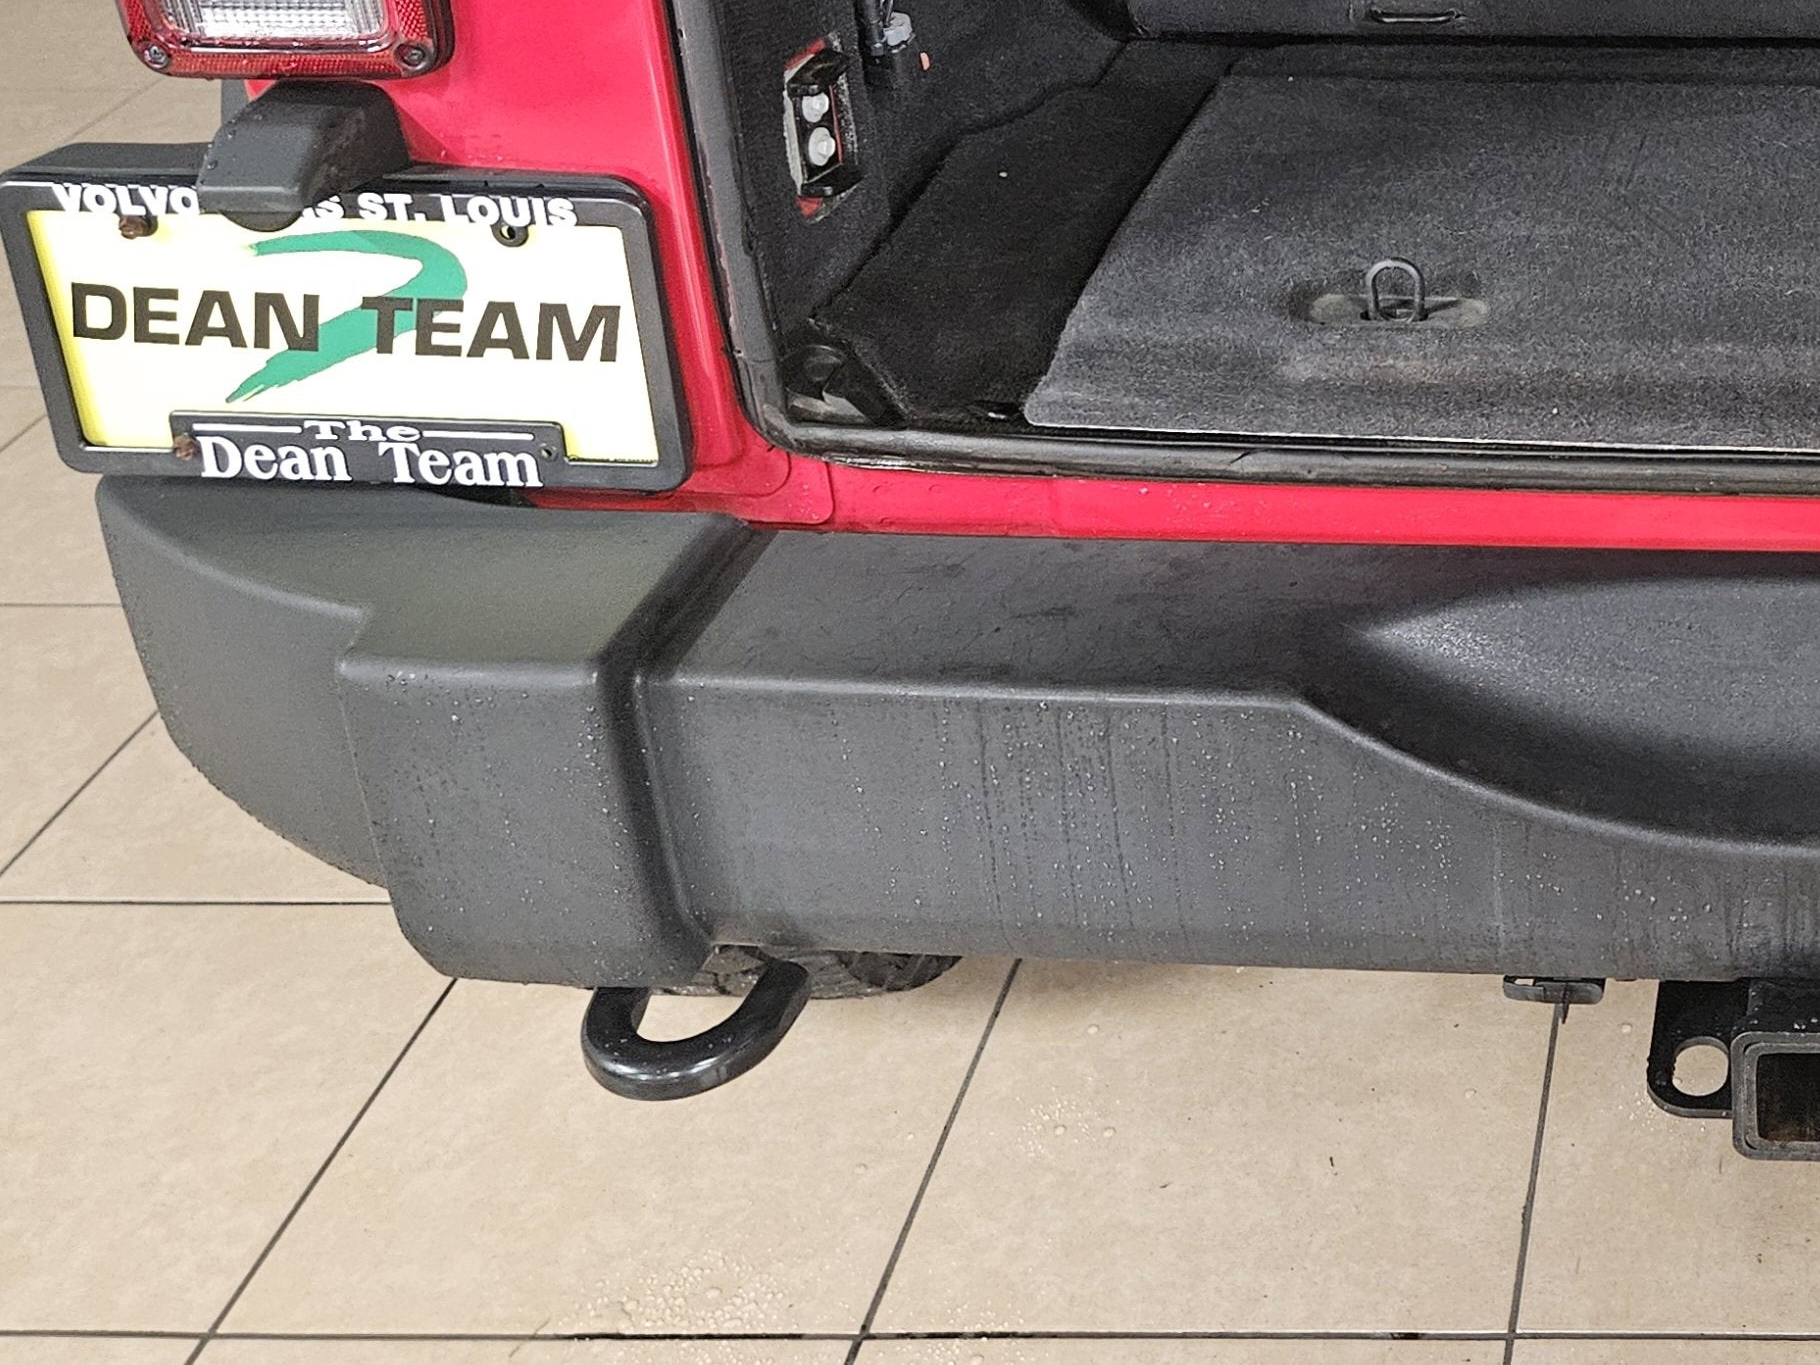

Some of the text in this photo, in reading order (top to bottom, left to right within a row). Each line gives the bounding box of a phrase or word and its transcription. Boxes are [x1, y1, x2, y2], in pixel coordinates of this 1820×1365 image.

[52, 183, 200, 216] VOLVO
[358, 192, 426, 222] ST.
[440, 194, 578, 227] LOUIS
[71, 282, 621, 362] DEAN TEAM
[304, 420, 421, 442] The
[195, 435, 543, 487] Dean Team
